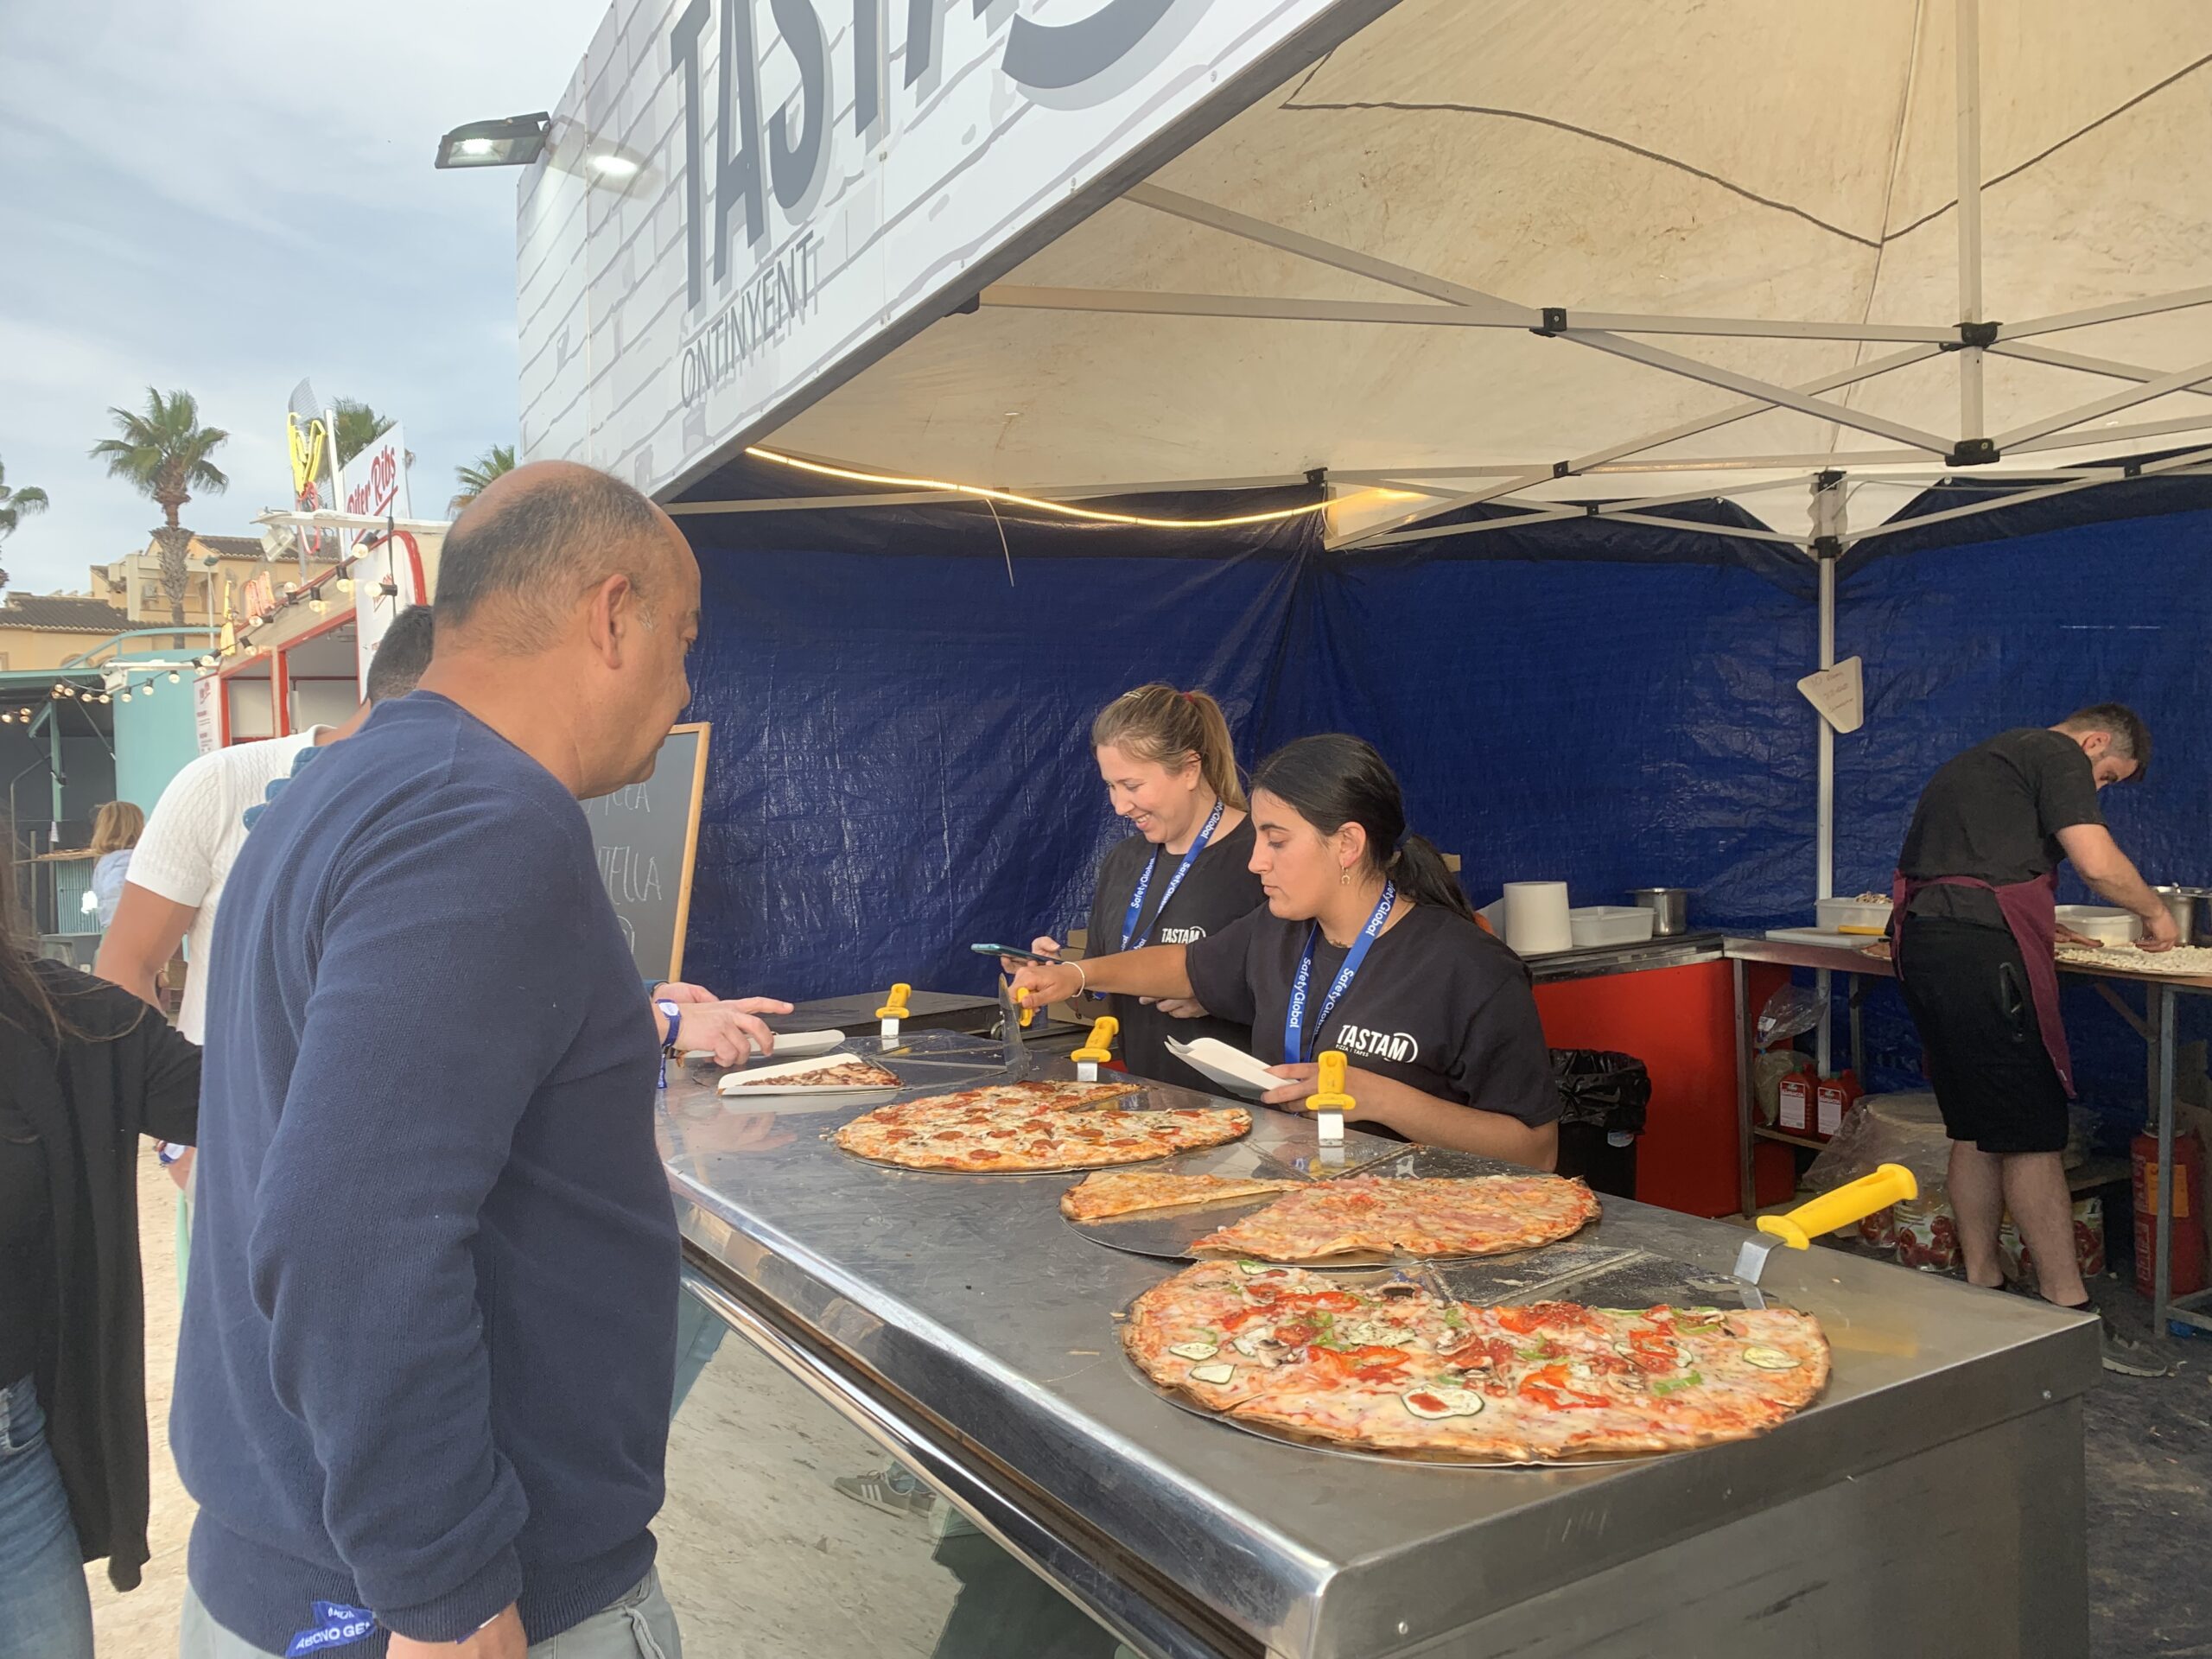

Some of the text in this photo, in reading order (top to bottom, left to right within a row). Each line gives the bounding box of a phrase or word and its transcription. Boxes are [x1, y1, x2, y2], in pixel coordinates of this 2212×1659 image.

[681, 228, 815, 409] ONTINYENT
[371, 444, 397, 507] Ribs
[1161, 928, 1200, 944] TASTAM
[1289, 957, 1312, 1028] SafetyGlobal
[1337, 1025, 1409, 1062] TASTAM
[296, 1627, 341, 1649] ABONO
